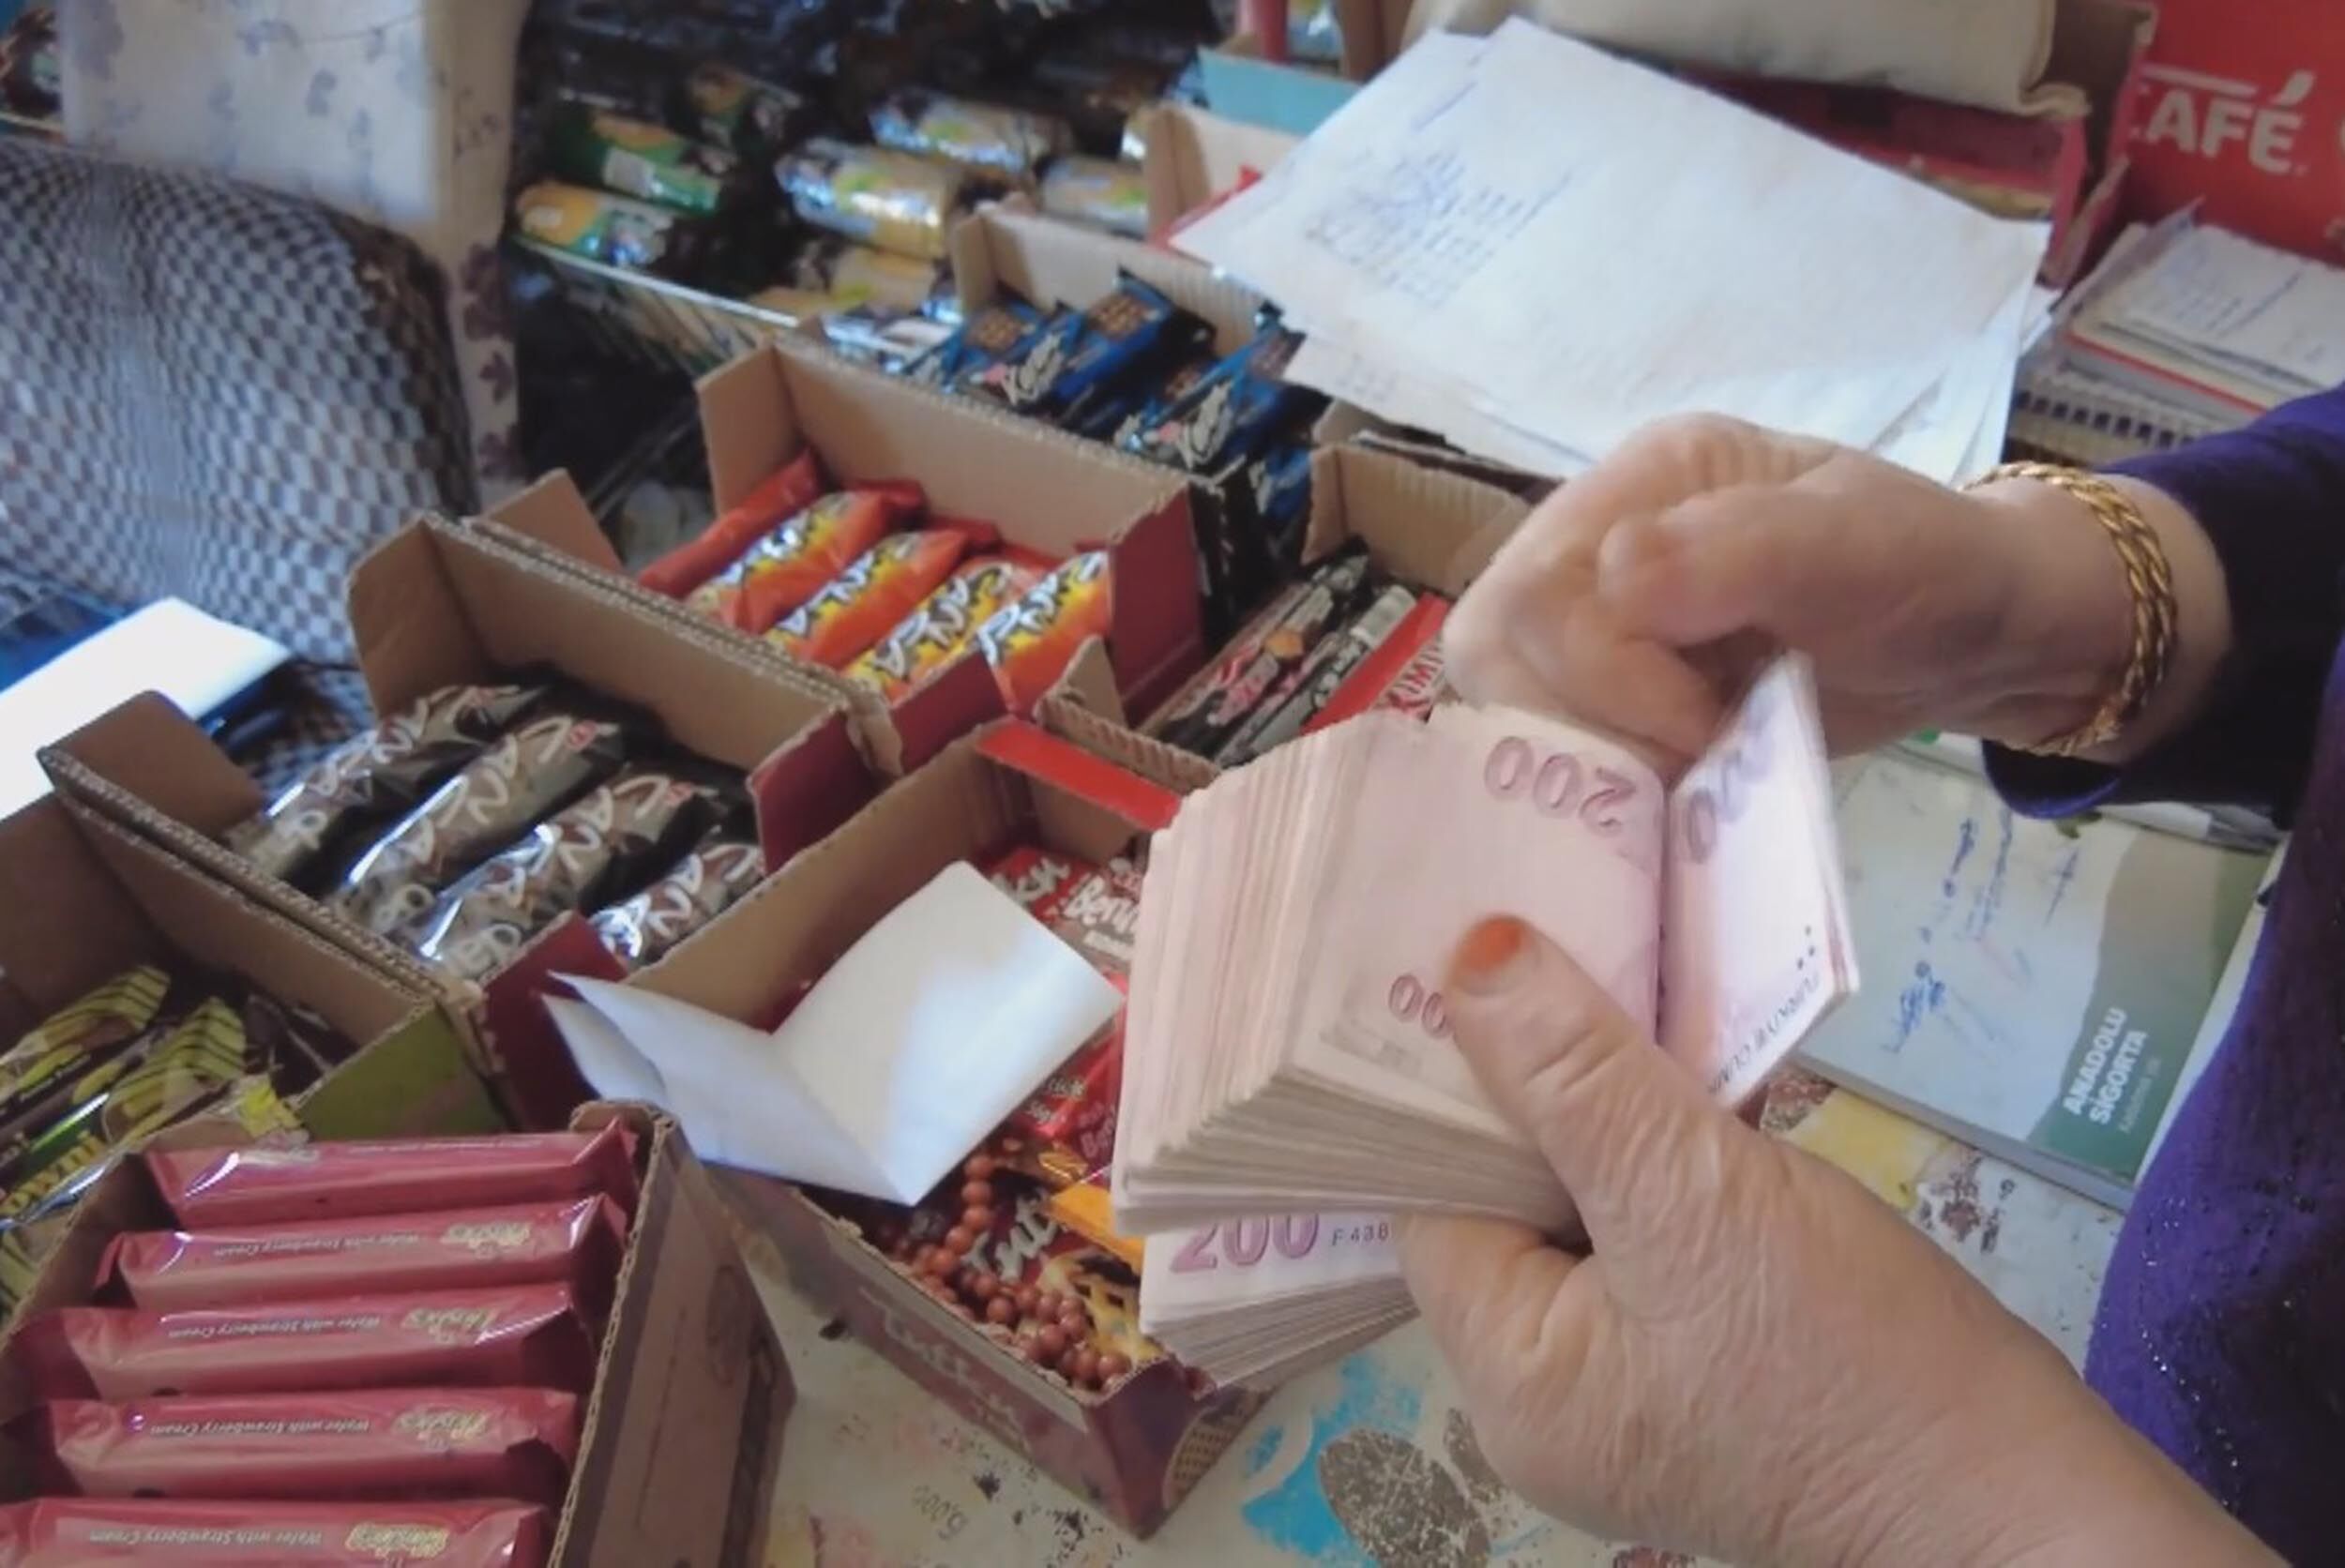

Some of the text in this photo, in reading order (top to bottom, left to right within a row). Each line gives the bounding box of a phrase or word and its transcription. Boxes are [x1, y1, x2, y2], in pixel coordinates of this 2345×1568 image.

[1484, 734, 1639, 837] 200
[1388, 972, 1454, 1039] 00
[2063, 1007, 2127, 1118] ANADOLU
[2090, 1029, 2149, 1127] SİGORTA
[1171, 1213, 1321, 1274] 200
[88, 1524, 322, 1549] Wafer with Strawberry Cream
